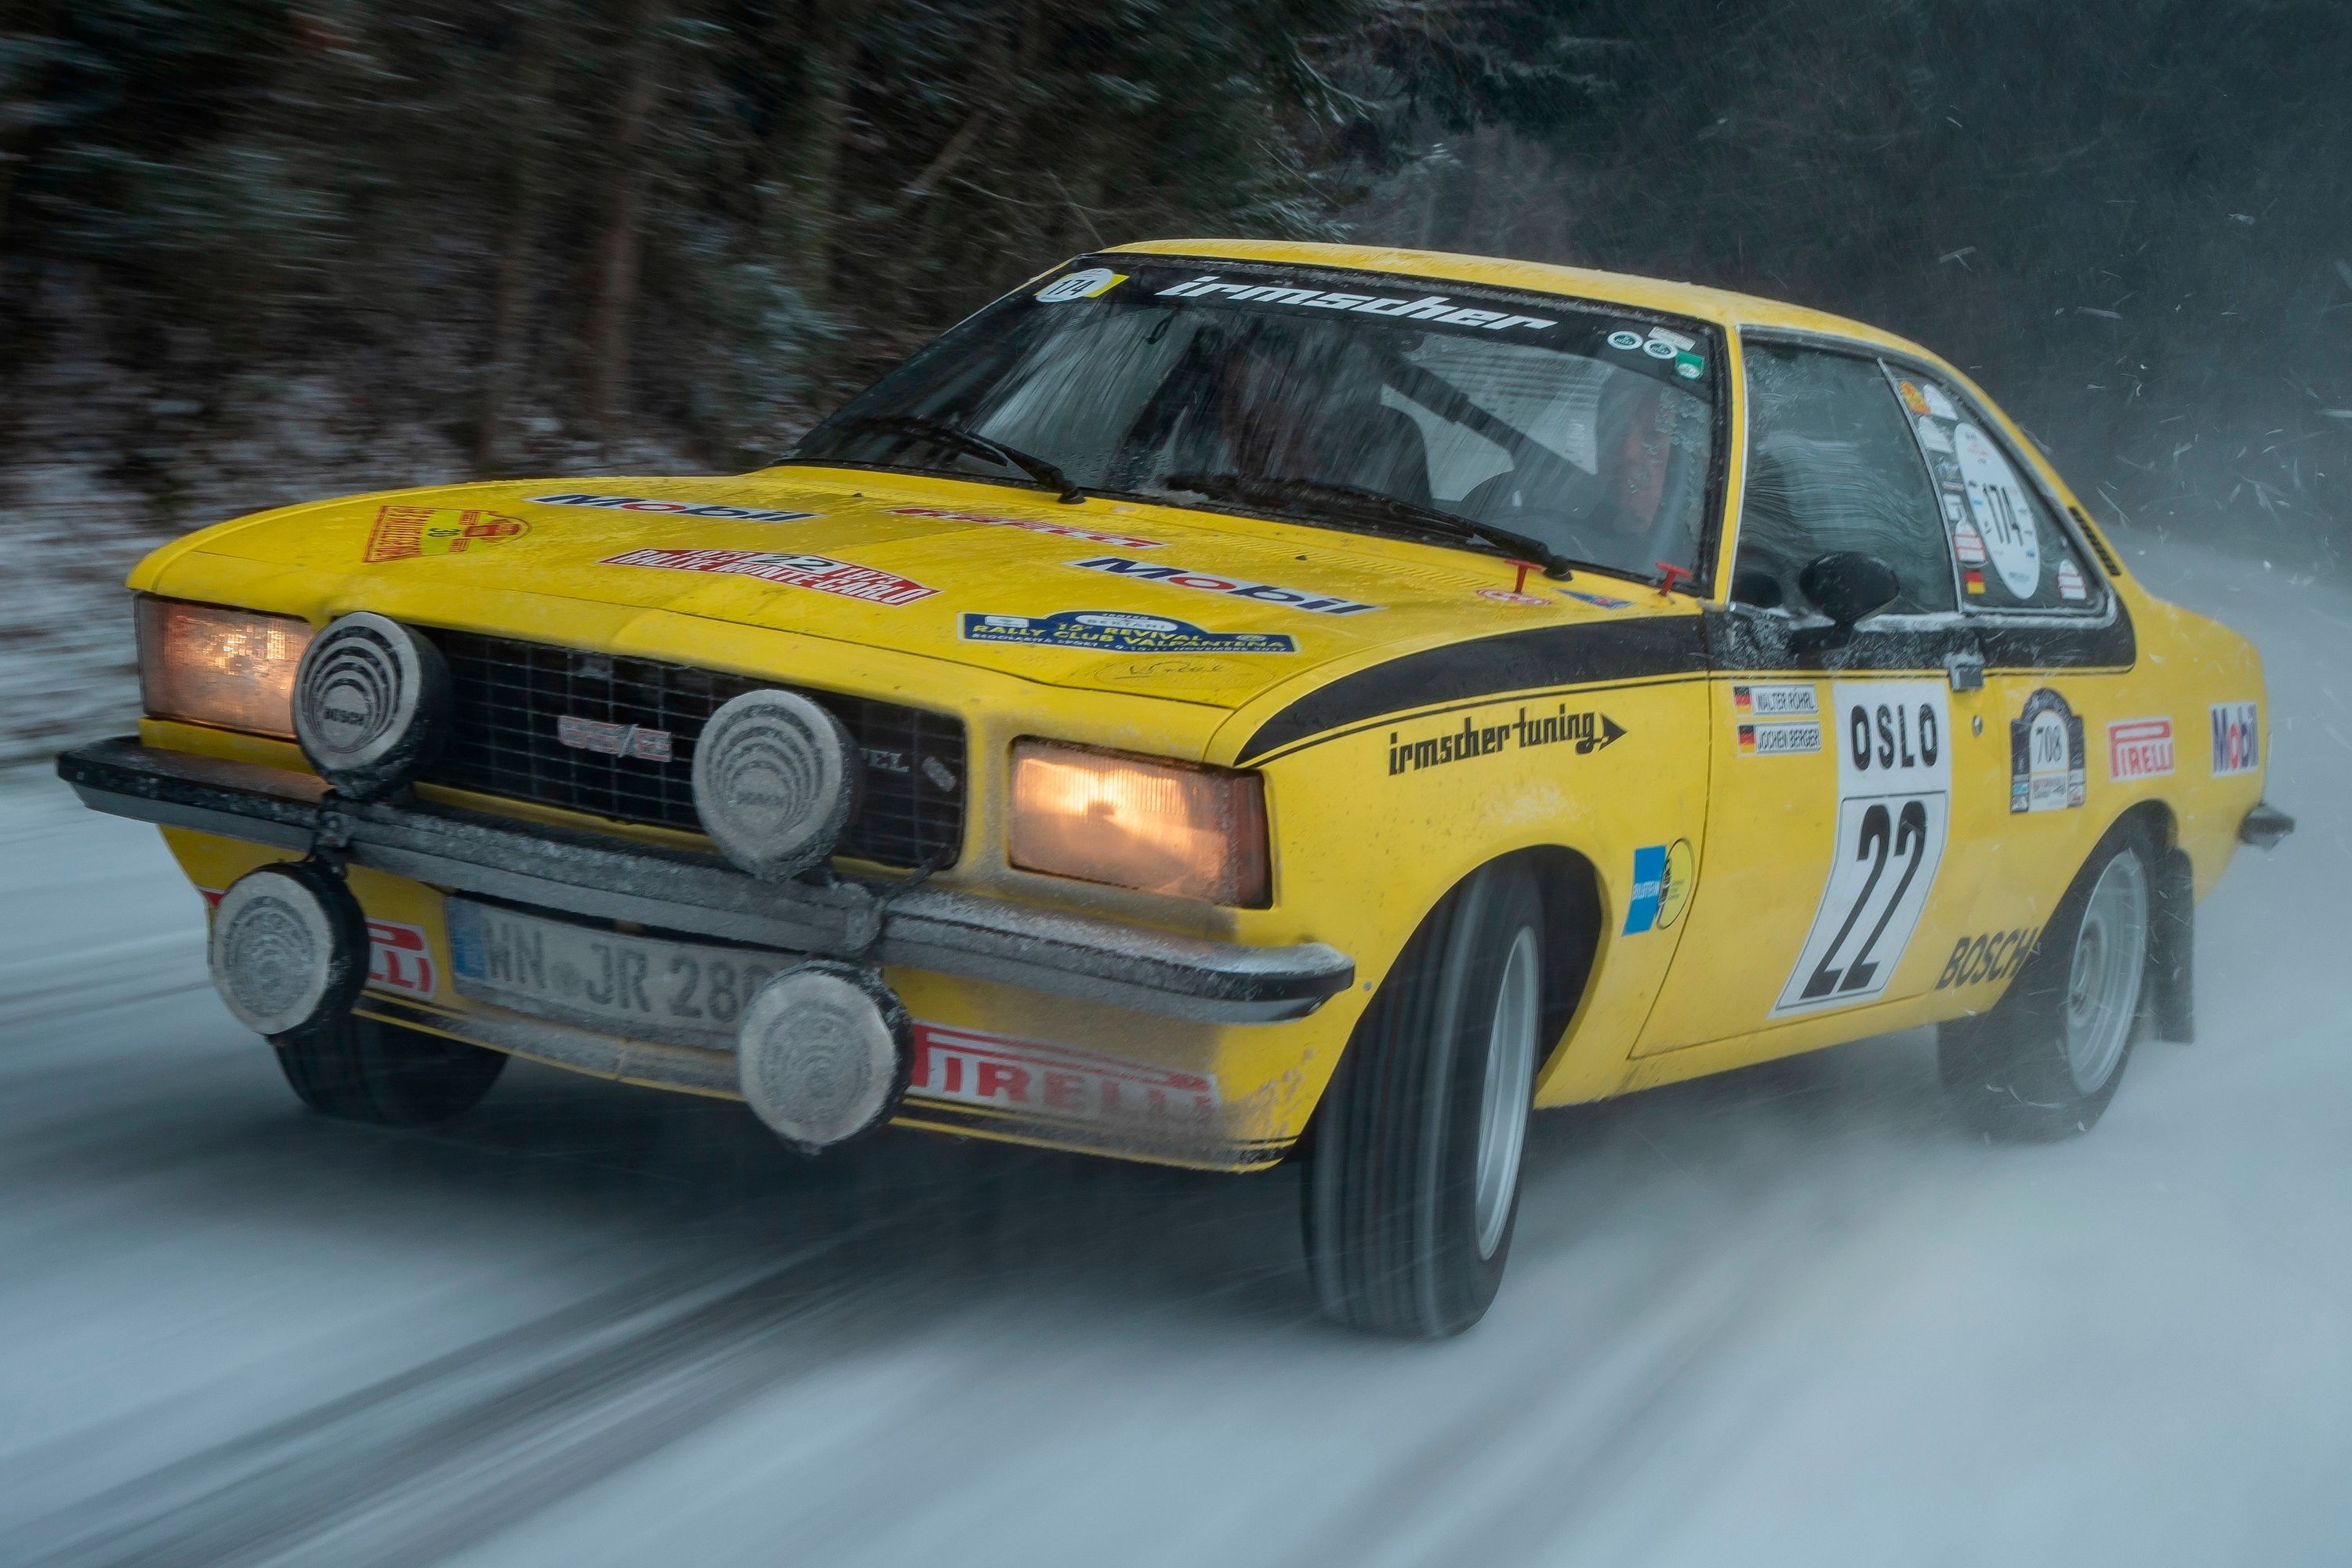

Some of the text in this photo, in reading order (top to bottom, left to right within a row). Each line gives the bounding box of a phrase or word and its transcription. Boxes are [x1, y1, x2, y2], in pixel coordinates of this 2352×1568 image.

[1046, 279, 1098, 296] 174
[1154, 276, 1559, 330] irmscher
[534, 494, 820, 521] Mobil
[612, 549, 717, 570] RALLYE
[681, 550, 904, 584] 1973 22 1973
[1074, 557, 1376, 614] Mobil
[972, 625, 1286, 648] RALLY CLUB VALPANTENA
[1103, 626, 1203, 641] REVIVAL
[1851, 702, 1937, 770] OSLO
[2109, 720, 2174, 778] PIRELLI
[1798, 800, 1927, 1001] 22
[586, 943, 651, 1012] JR
[1934, 927, 2038, 991] BOSCH
